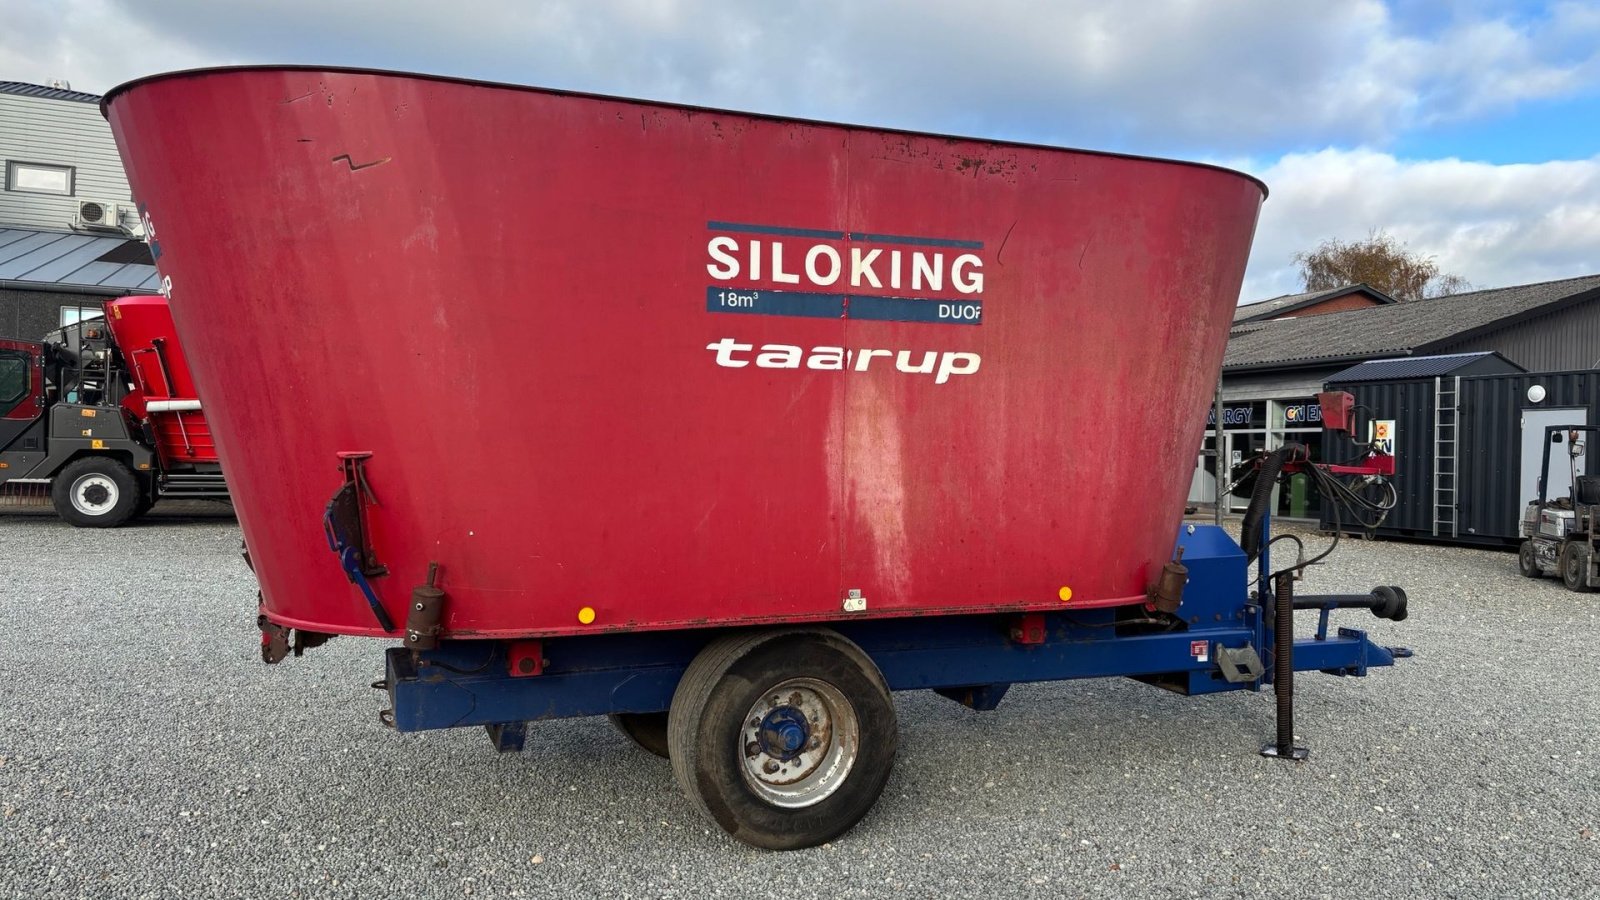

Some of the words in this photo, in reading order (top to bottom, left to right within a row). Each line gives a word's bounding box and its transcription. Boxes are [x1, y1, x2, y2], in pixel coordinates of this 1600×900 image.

[706, 236, 984, 294] SILOKING
[706, 338, 981, 385] taarup
[1207, 407, 1253, 424] NRGY
